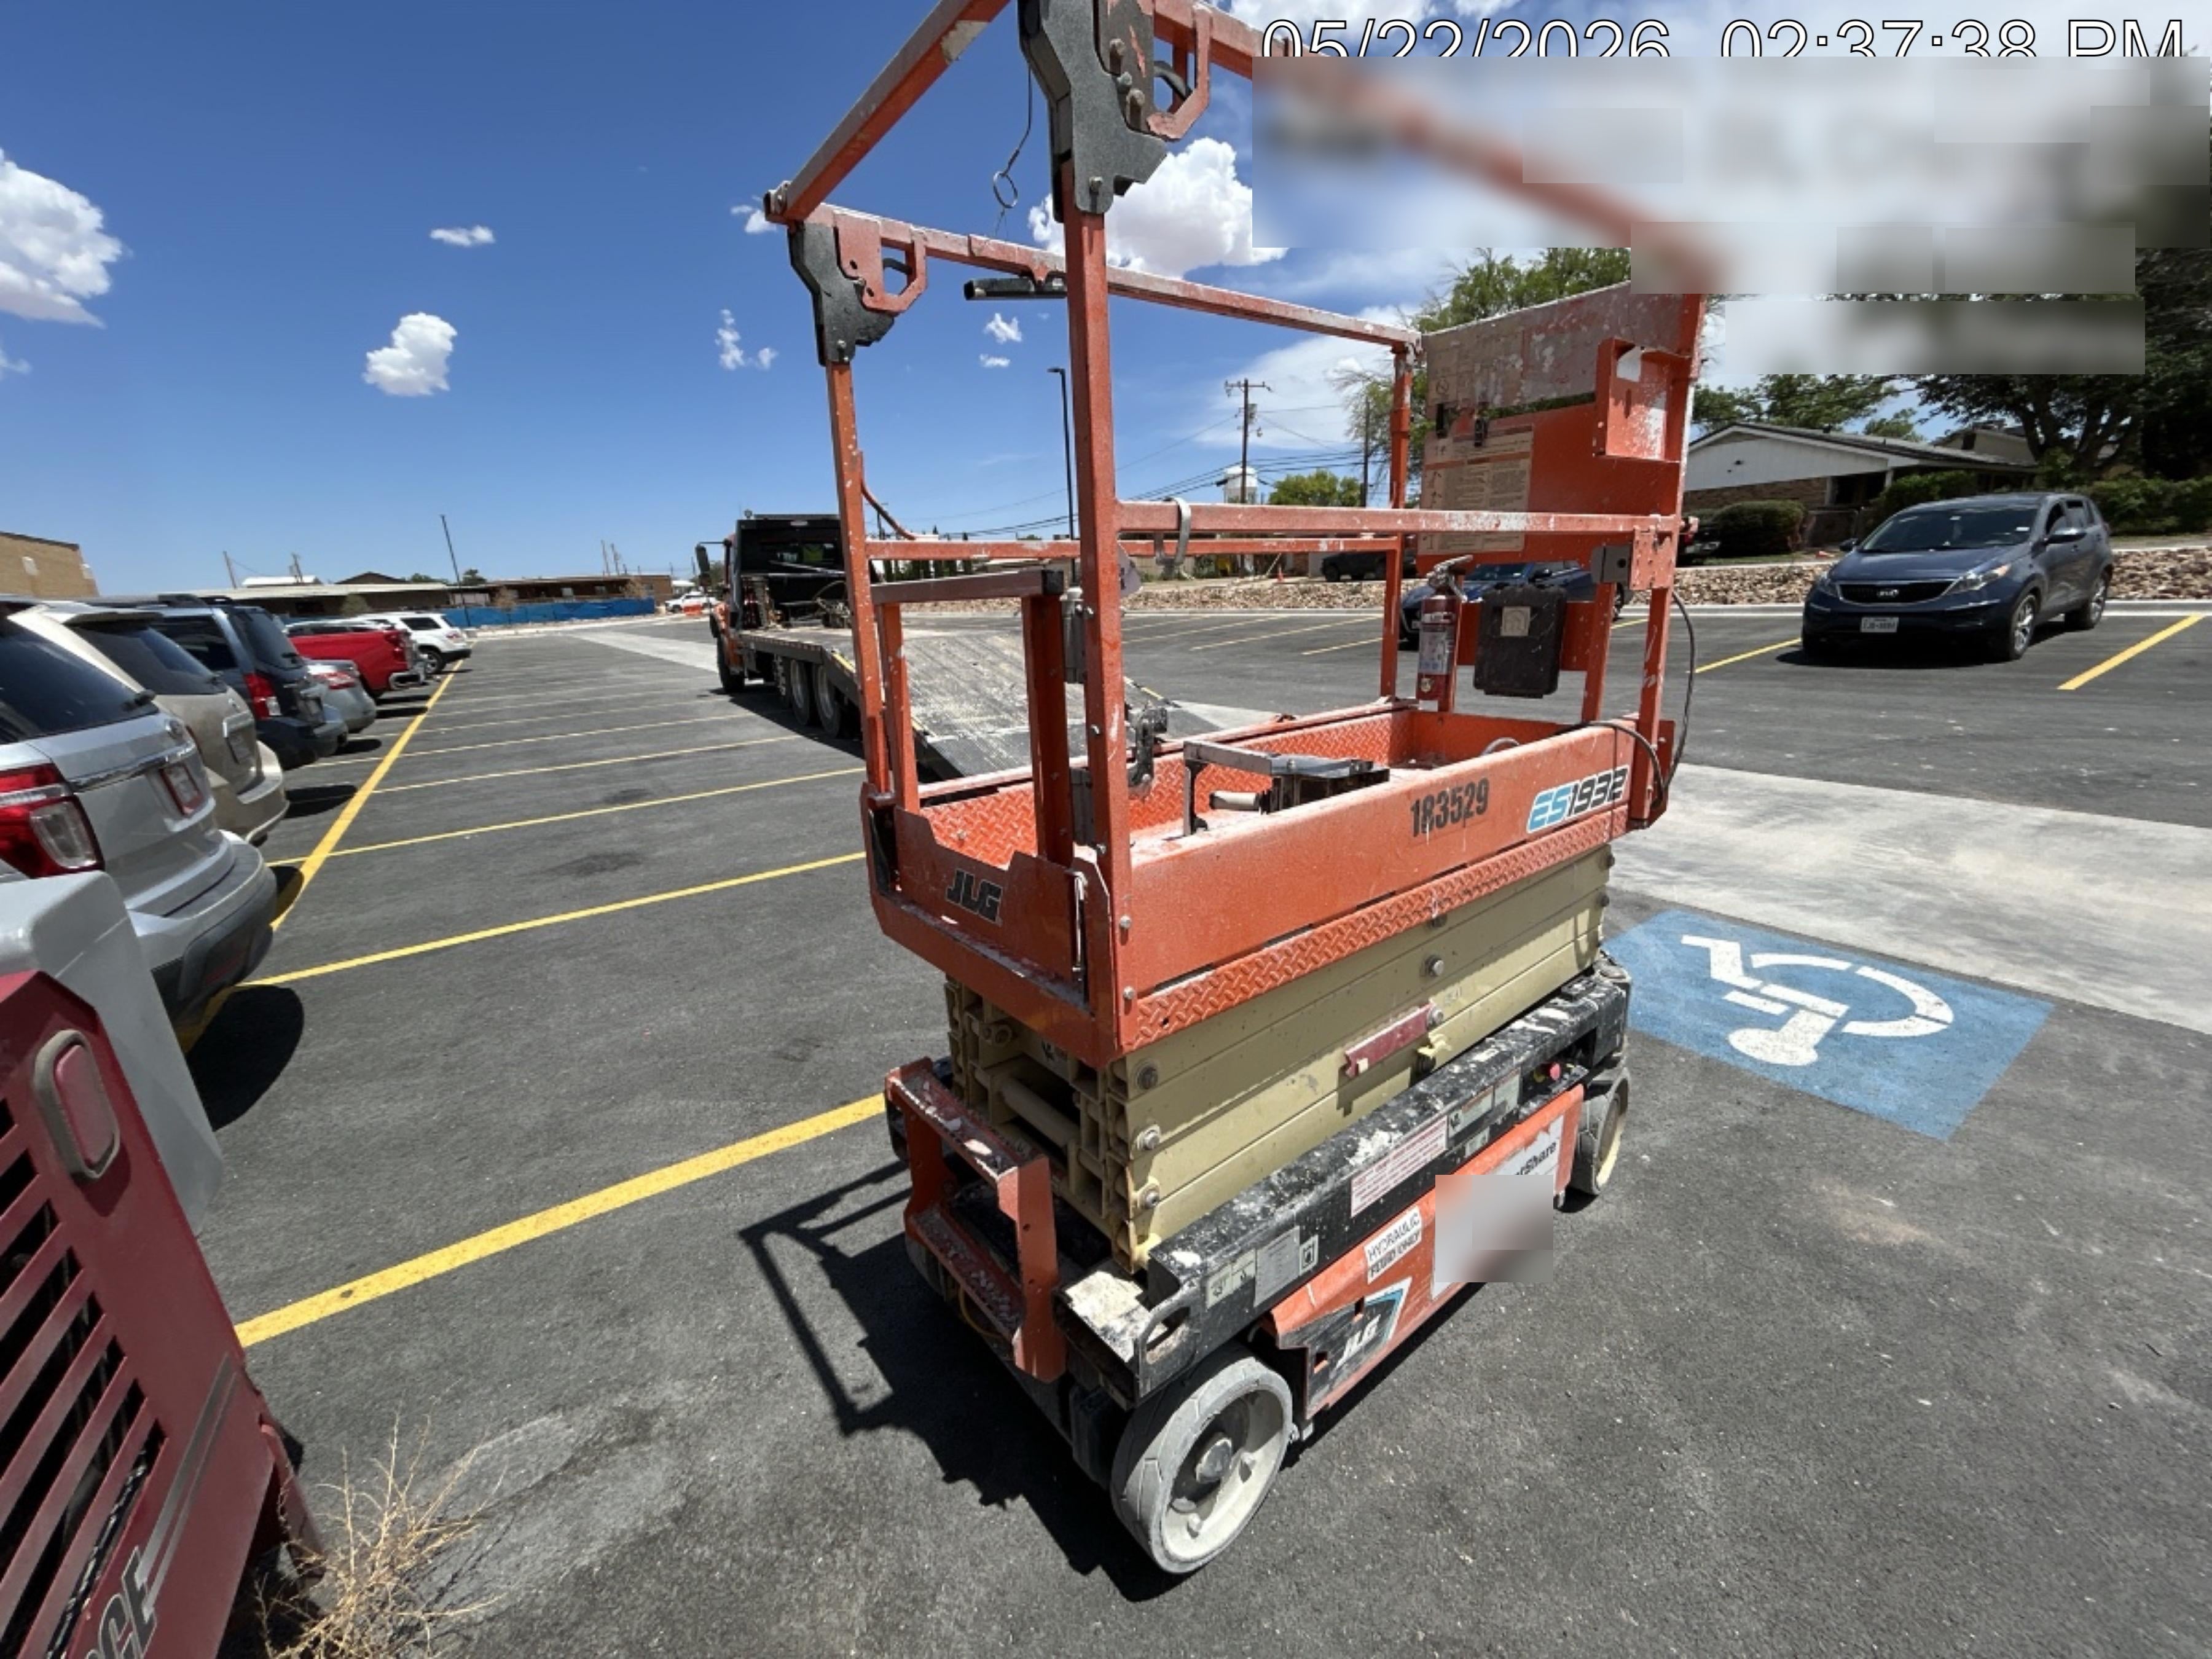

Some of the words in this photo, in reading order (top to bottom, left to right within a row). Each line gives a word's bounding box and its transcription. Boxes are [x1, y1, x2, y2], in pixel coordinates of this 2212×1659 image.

[1528, 767, 1629, 833] ES1932
[946, 868, 1002, 924] JLG
[1515, 1142, 1556, 1175] rShare
